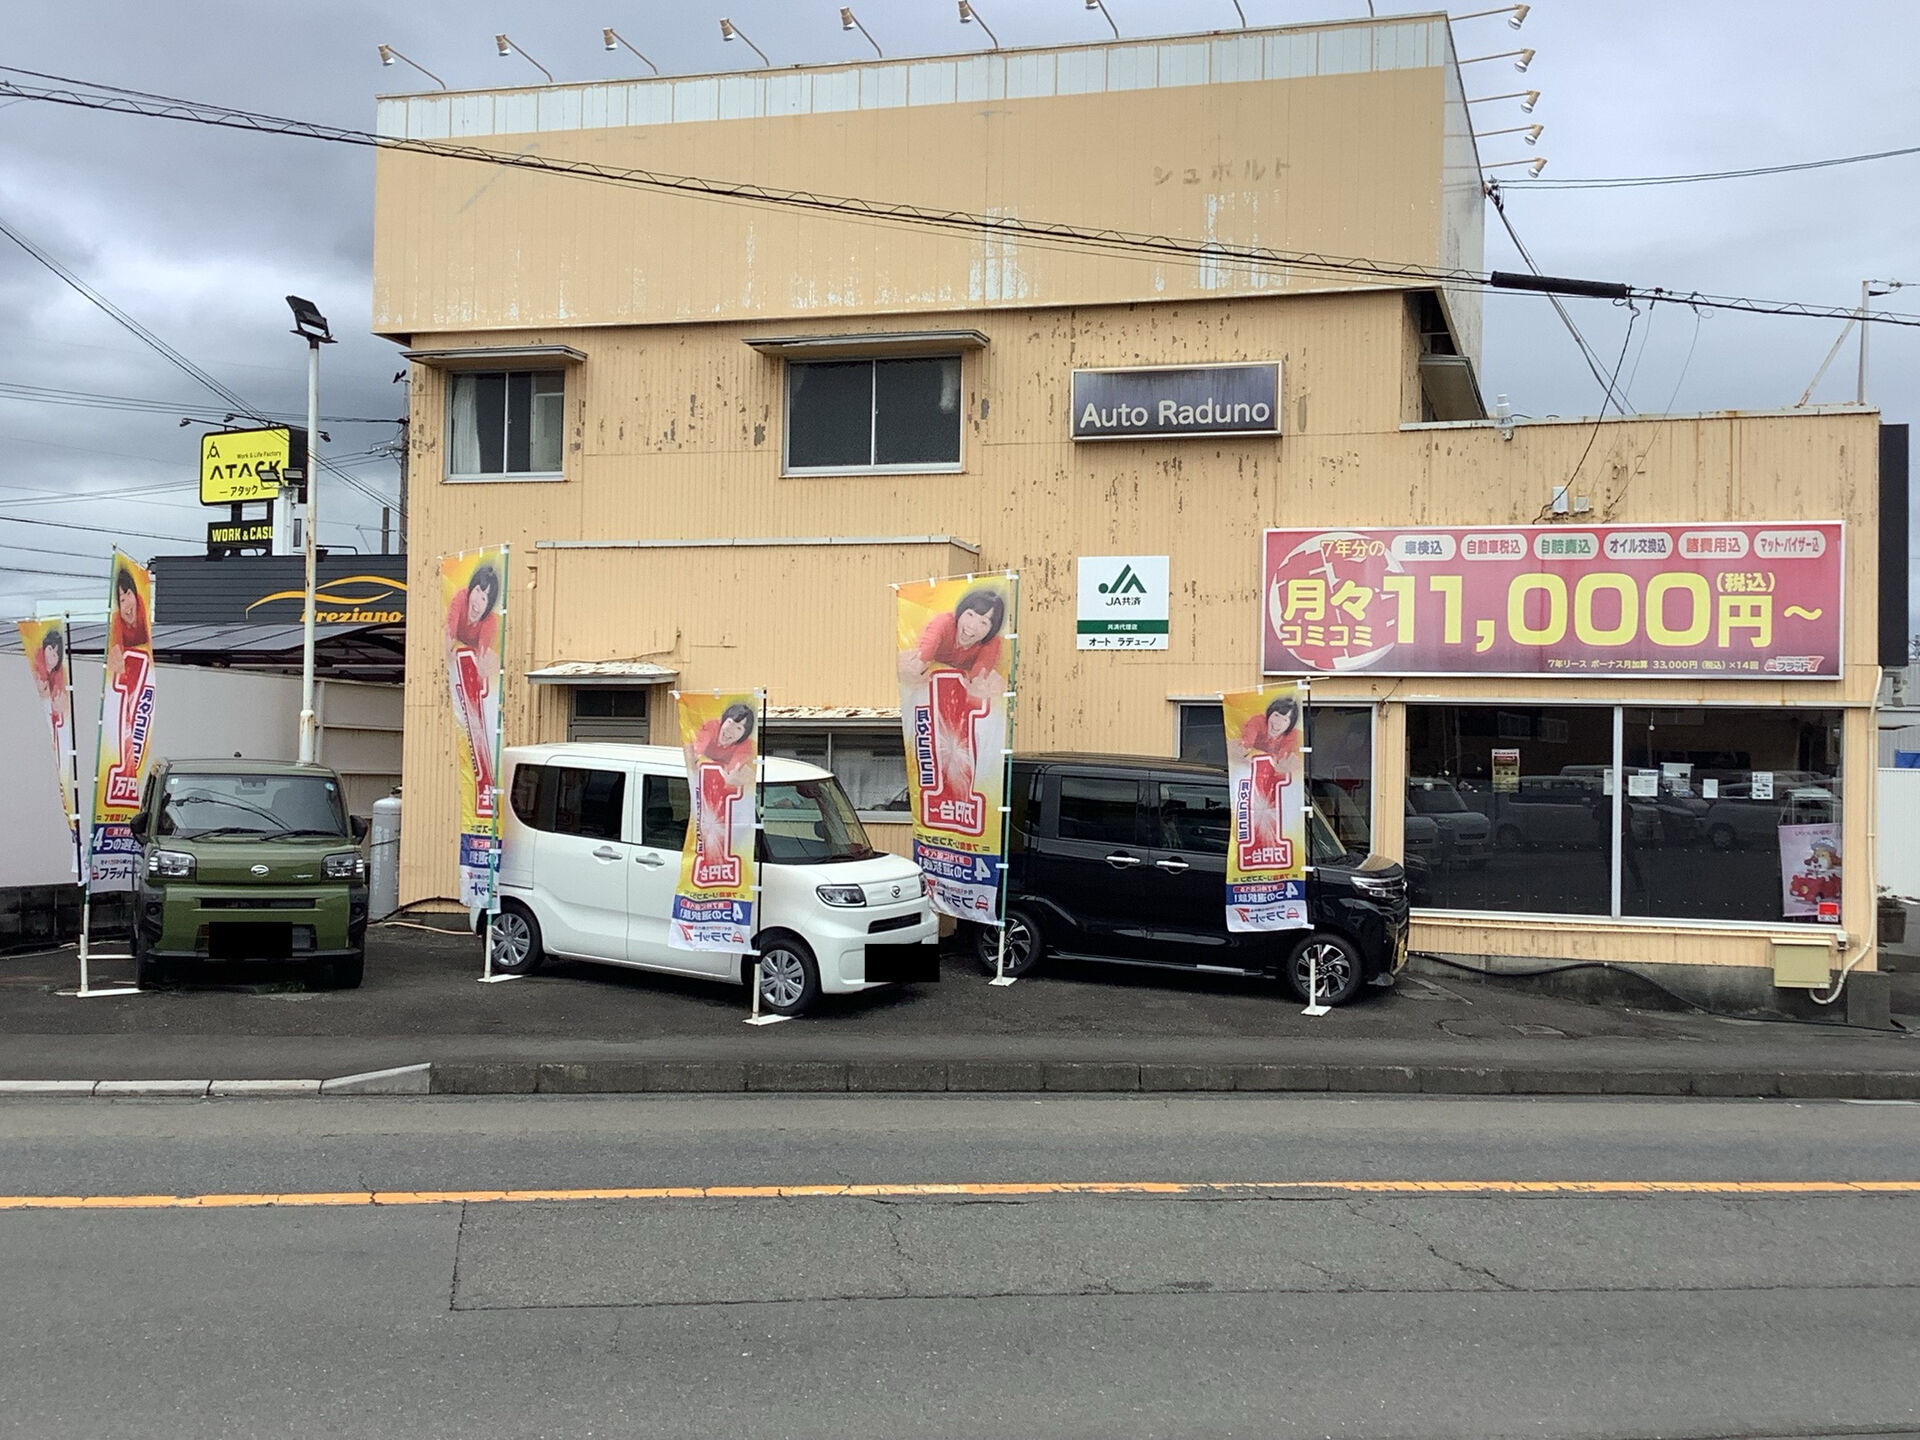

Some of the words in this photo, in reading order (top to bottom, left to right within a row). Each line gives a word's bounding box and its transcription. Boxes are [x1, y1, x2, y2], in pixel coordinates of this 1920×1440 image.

[1079, 402, 1149, 429] Auto
[1158, 397, 1271, 427] Raduno
[230, 485, 259, 497] アタック
[212, 527, 241, 542] WORK
[242, 530, 249, 541] &
[1319, 539, 1386, 558] 7年分の
[1404, 540, 1443, 556] 車検込
[1466, 539, 1521, 555] 自動車税込
[1609, 537, 1667, 554] オイル交換込
[1105, 596, 1142, 606] JA共済
[1282, 578, 1374, 622] 月々
[1088, 637, 1111, 647] オート
[1117, 637, 1157, 647] ラデューノ
[1281, 625, 1374, 648] コミコミ
